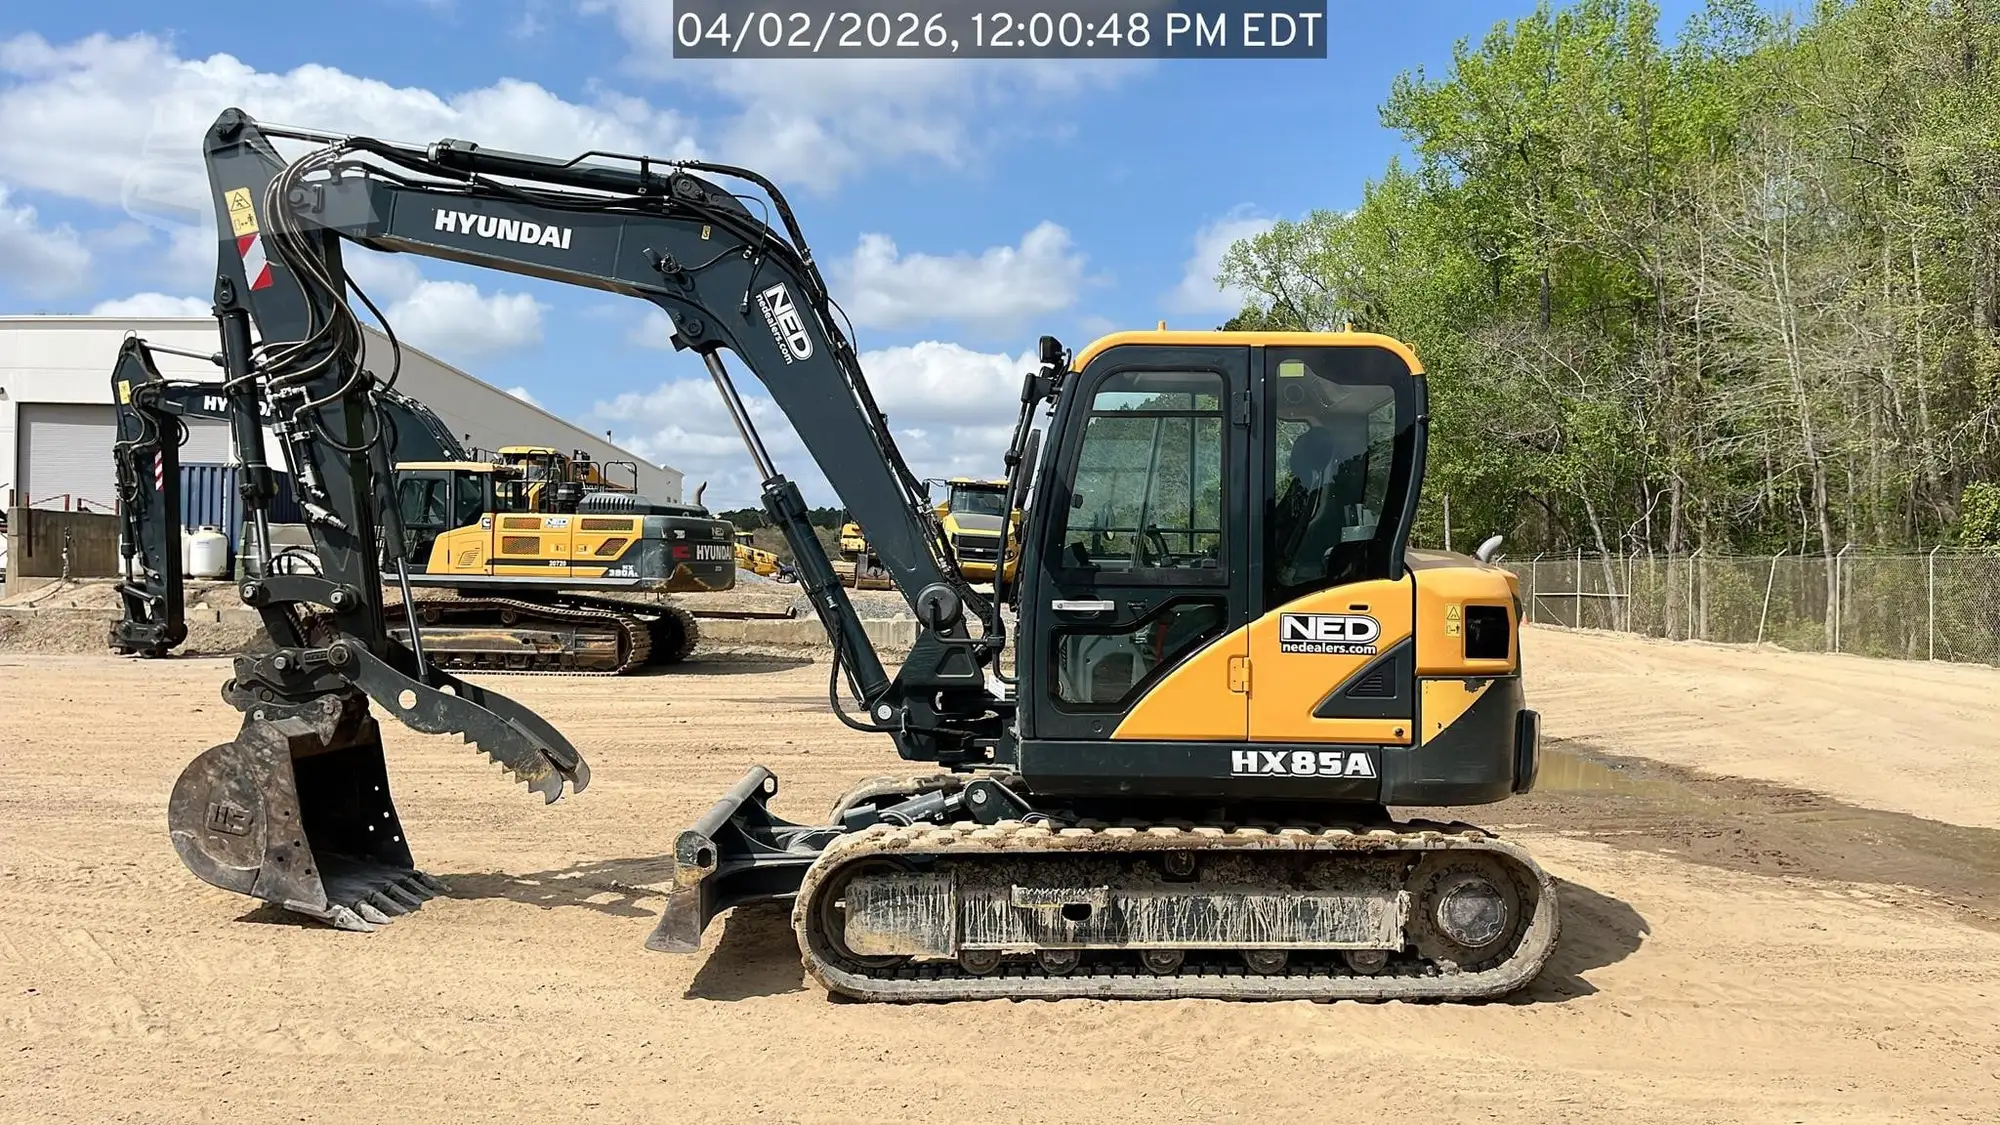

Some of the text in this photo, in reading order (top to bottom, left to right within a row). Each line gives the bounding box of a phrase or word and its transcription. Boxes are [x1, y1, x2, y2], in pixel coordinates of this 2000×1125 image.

[434, 208, 572, 250] HYUNDAI
[755, 293, 794, 365] nedealers.com
[766, 284, 812, 359] NED
[696, 544, 732, 561] HYUNDAI
[1282, 615, 1378, 641] NED
[1282, 642, 1376, 654] nedealers.com
[1230, 750, 1377, 778] HX85A
